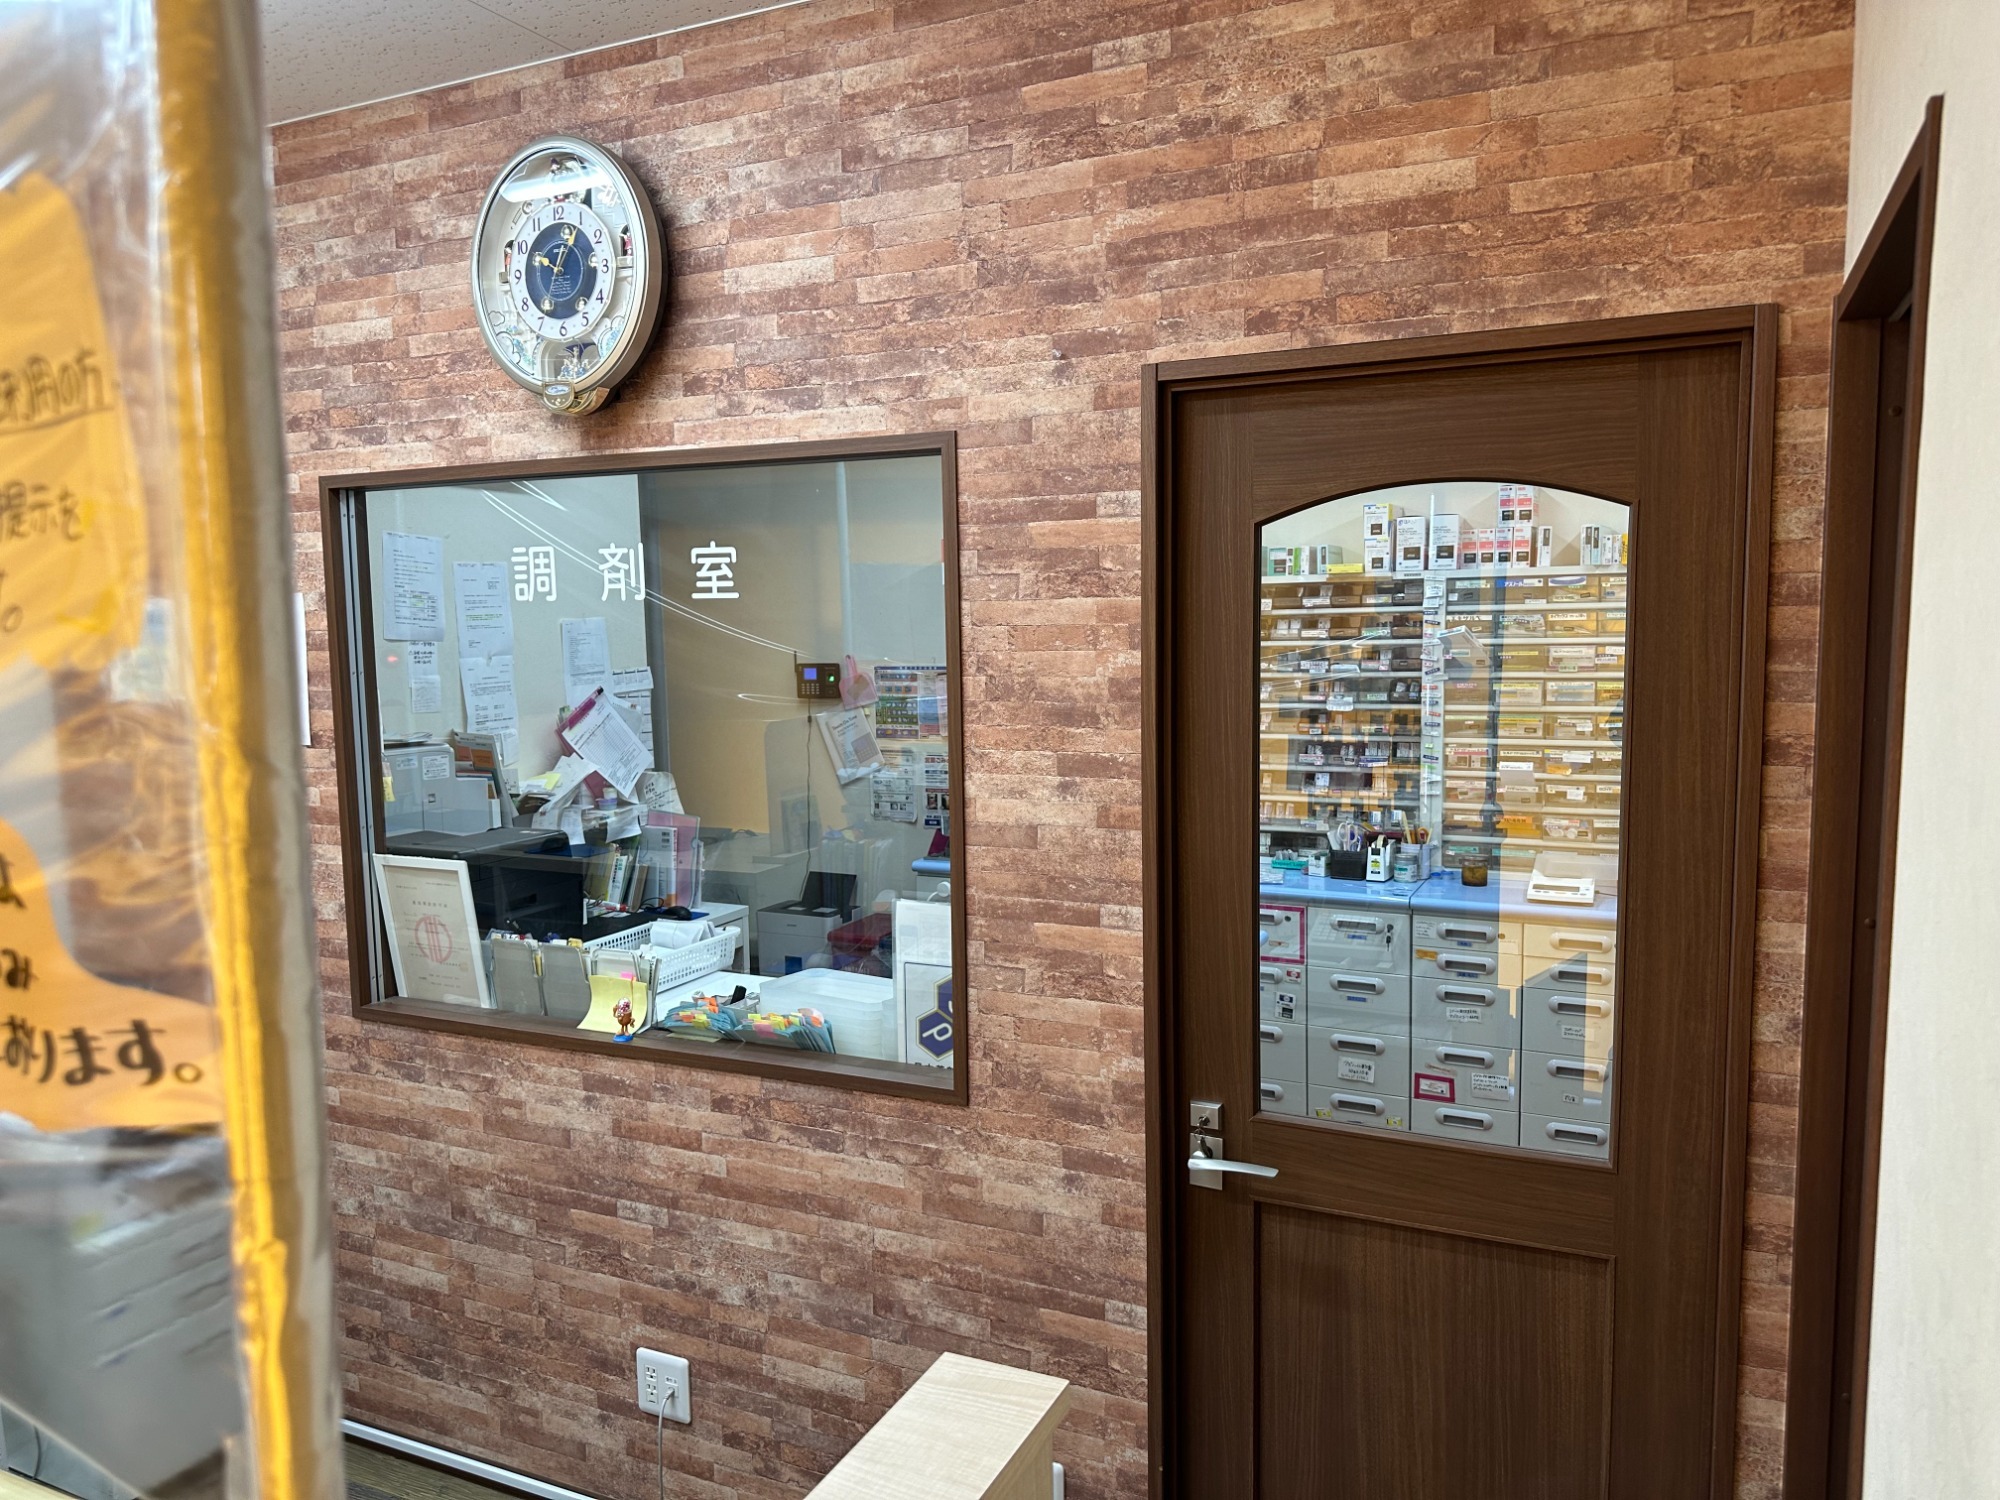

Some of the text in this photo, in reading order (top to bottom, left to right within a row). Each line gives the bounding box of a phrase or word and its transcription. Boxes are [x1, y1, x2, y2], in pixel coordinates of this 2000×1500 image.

[553, 205, 565, 221] 12
[532, 217, 541, 232] 11
[593, 228, 603, 245] 2
[517, 239, 528, 256] 10
[601, 258, 610, 274] 3
[514, 269, 523, 285] 9
[521, 296, 530, 312] 8
[595, 288, 604, 304] 4
[537, 316, 546, 332] 7
[581, 311, 590, 327] 5
[559, 321, 568, 337] 6
[511, 541, 740, 602] 調剤室
